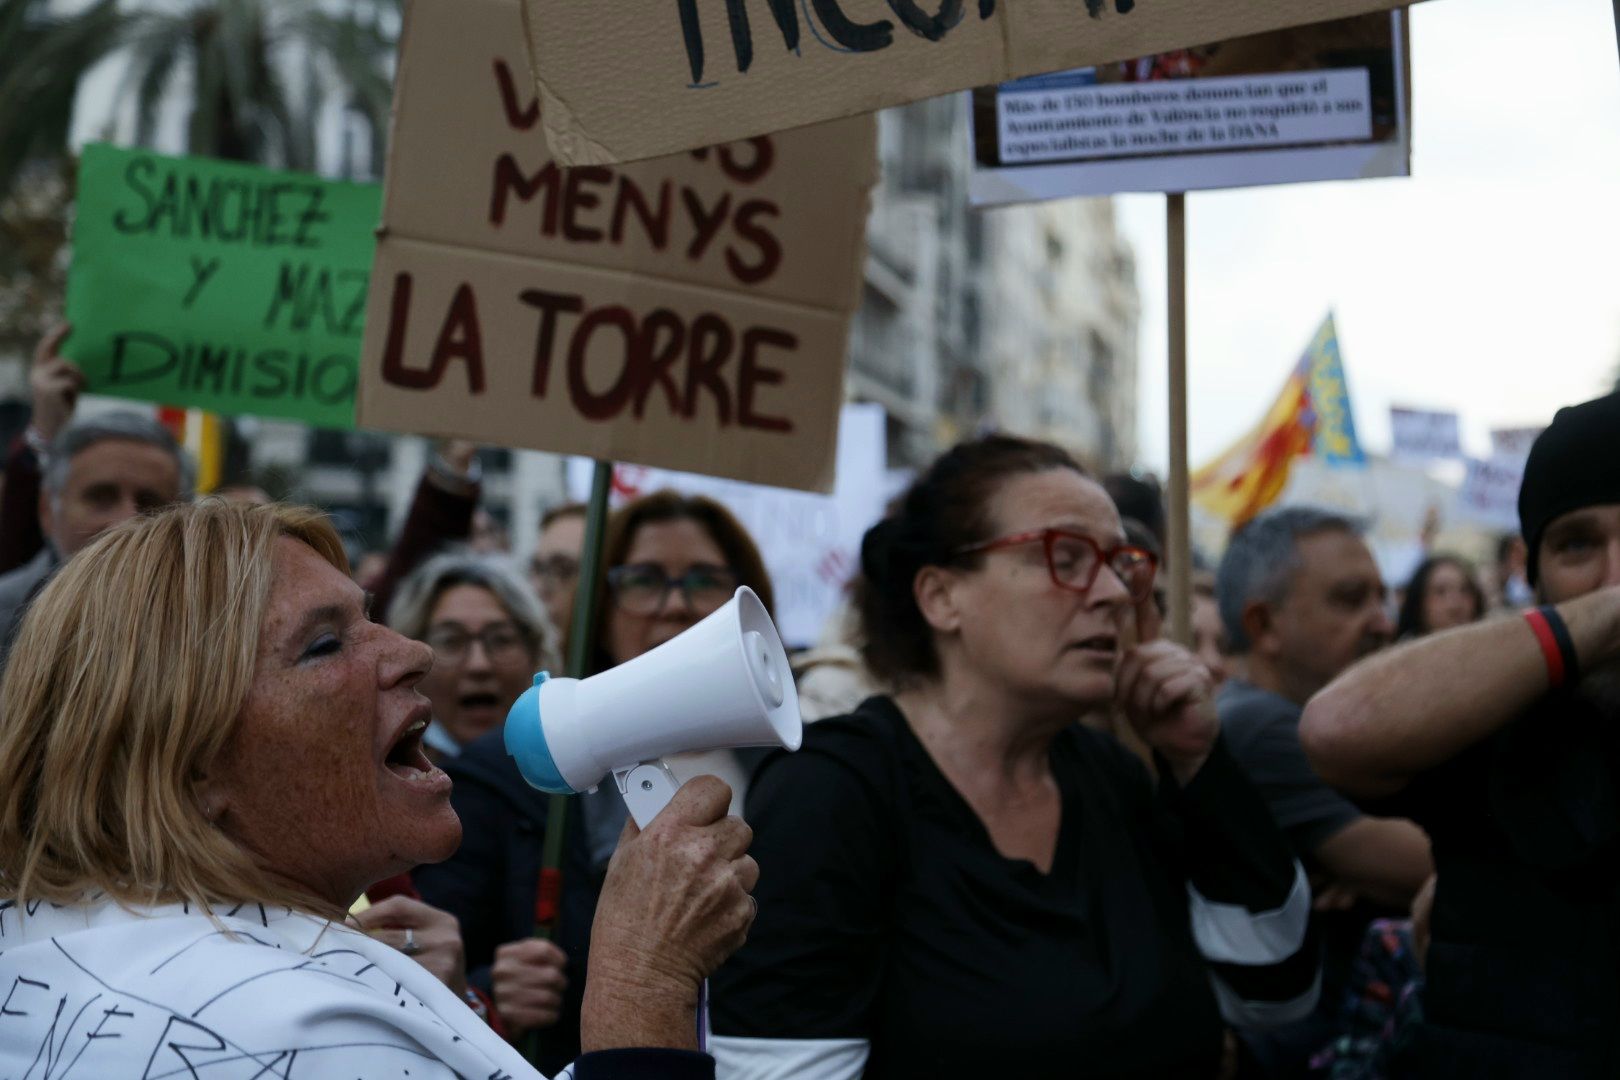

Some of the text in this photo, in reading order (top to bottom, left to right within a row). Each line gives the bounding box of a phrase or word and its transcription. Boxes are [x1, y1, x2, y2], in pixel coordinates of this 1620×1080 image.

[1008, 115, 1121, 135] Ayuntamiento
[1127, 112, 1145, 125] de
[1224, 108, 1247, 119] no
[1323, 104, 1333, 114] a
[1336, 101, 1362, 113] sus
[1041, 98, 1058, 113] de
[1095, 88, 1179, 107] bomberos
[1185, 79, 1273, 101] denuncian
[1277, 81, 1305, 98] que
[1312, 78, 1328, 93] el
[1007, 123, 1279, 155] especialistas la noche de la DANA
[488, 152, 784, 286] MENYS
[183, 258, 368, 336] Y MAZ
[105, 330, 358, 405] DIMISIO
[381, 271, 800, 435] LA TORRE
